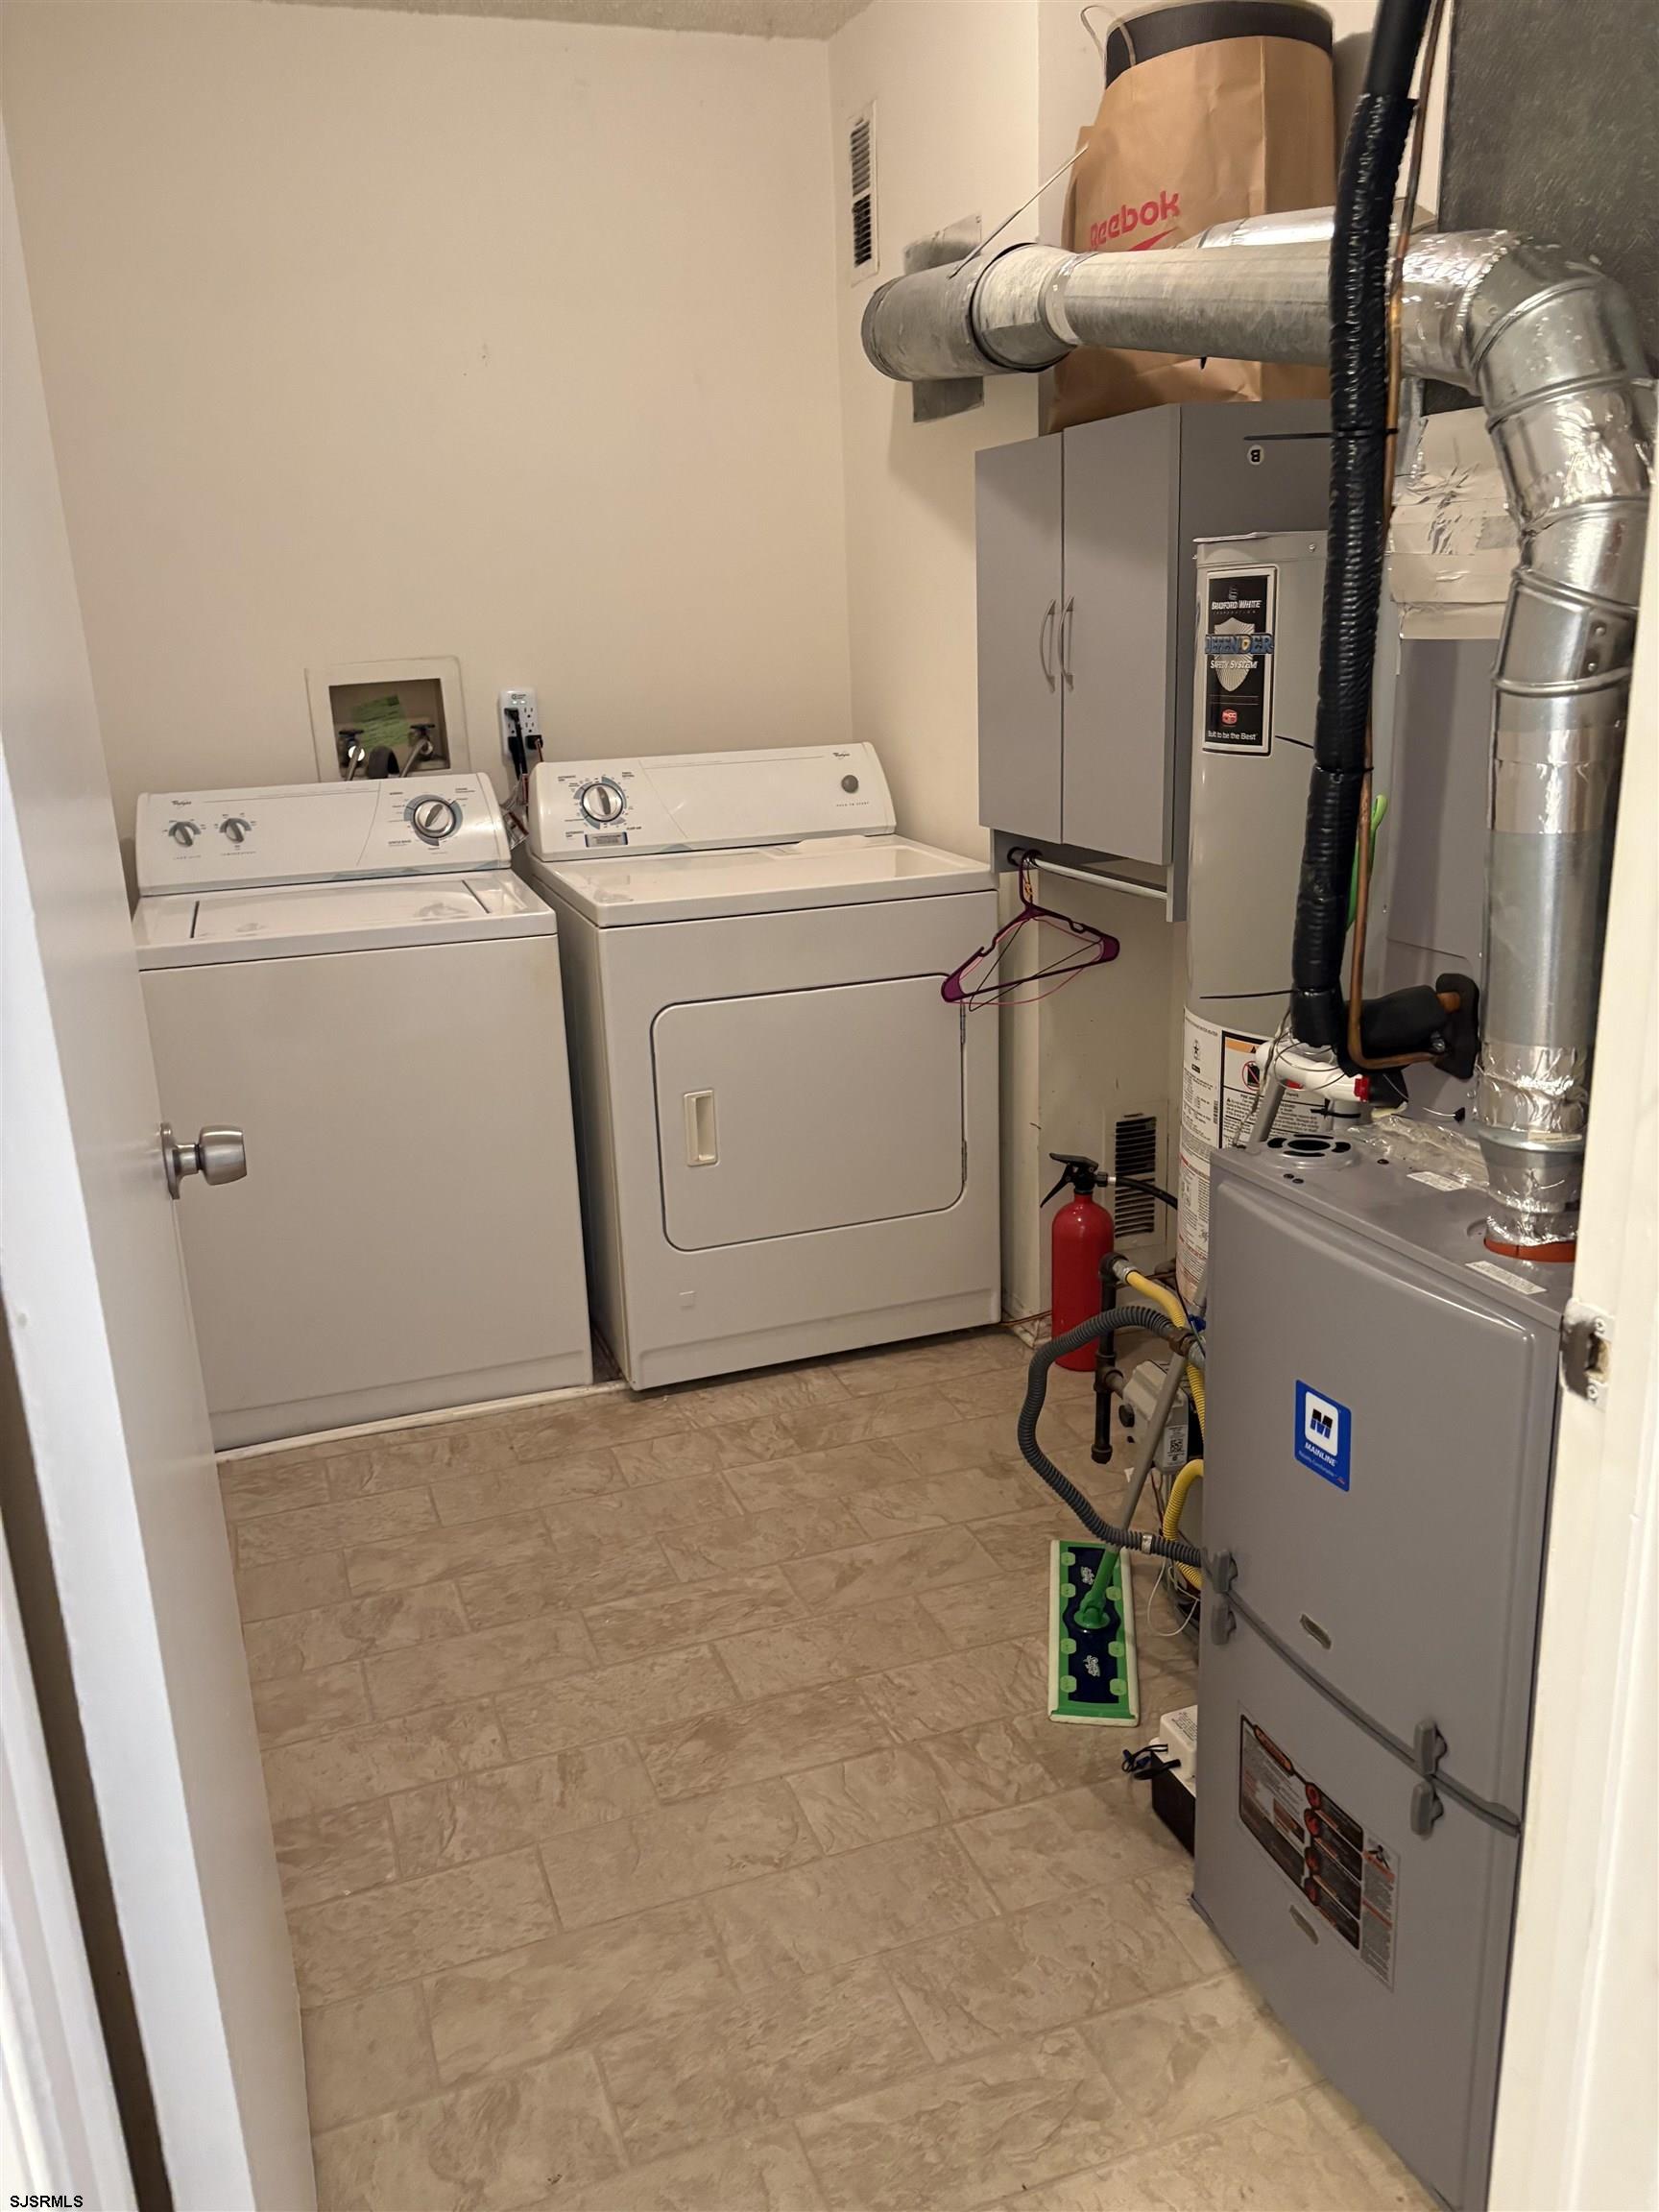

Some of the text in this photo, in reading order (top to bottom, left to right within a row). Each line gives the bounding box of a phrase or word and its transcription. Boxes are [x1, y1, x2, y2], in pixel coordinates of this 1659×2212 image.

[1090, 190, 1182, 250] Reebok
[1230, 660, 1259, 669] SYSTEM
[1305, 1441, 1336, 1467] MAINLINE
